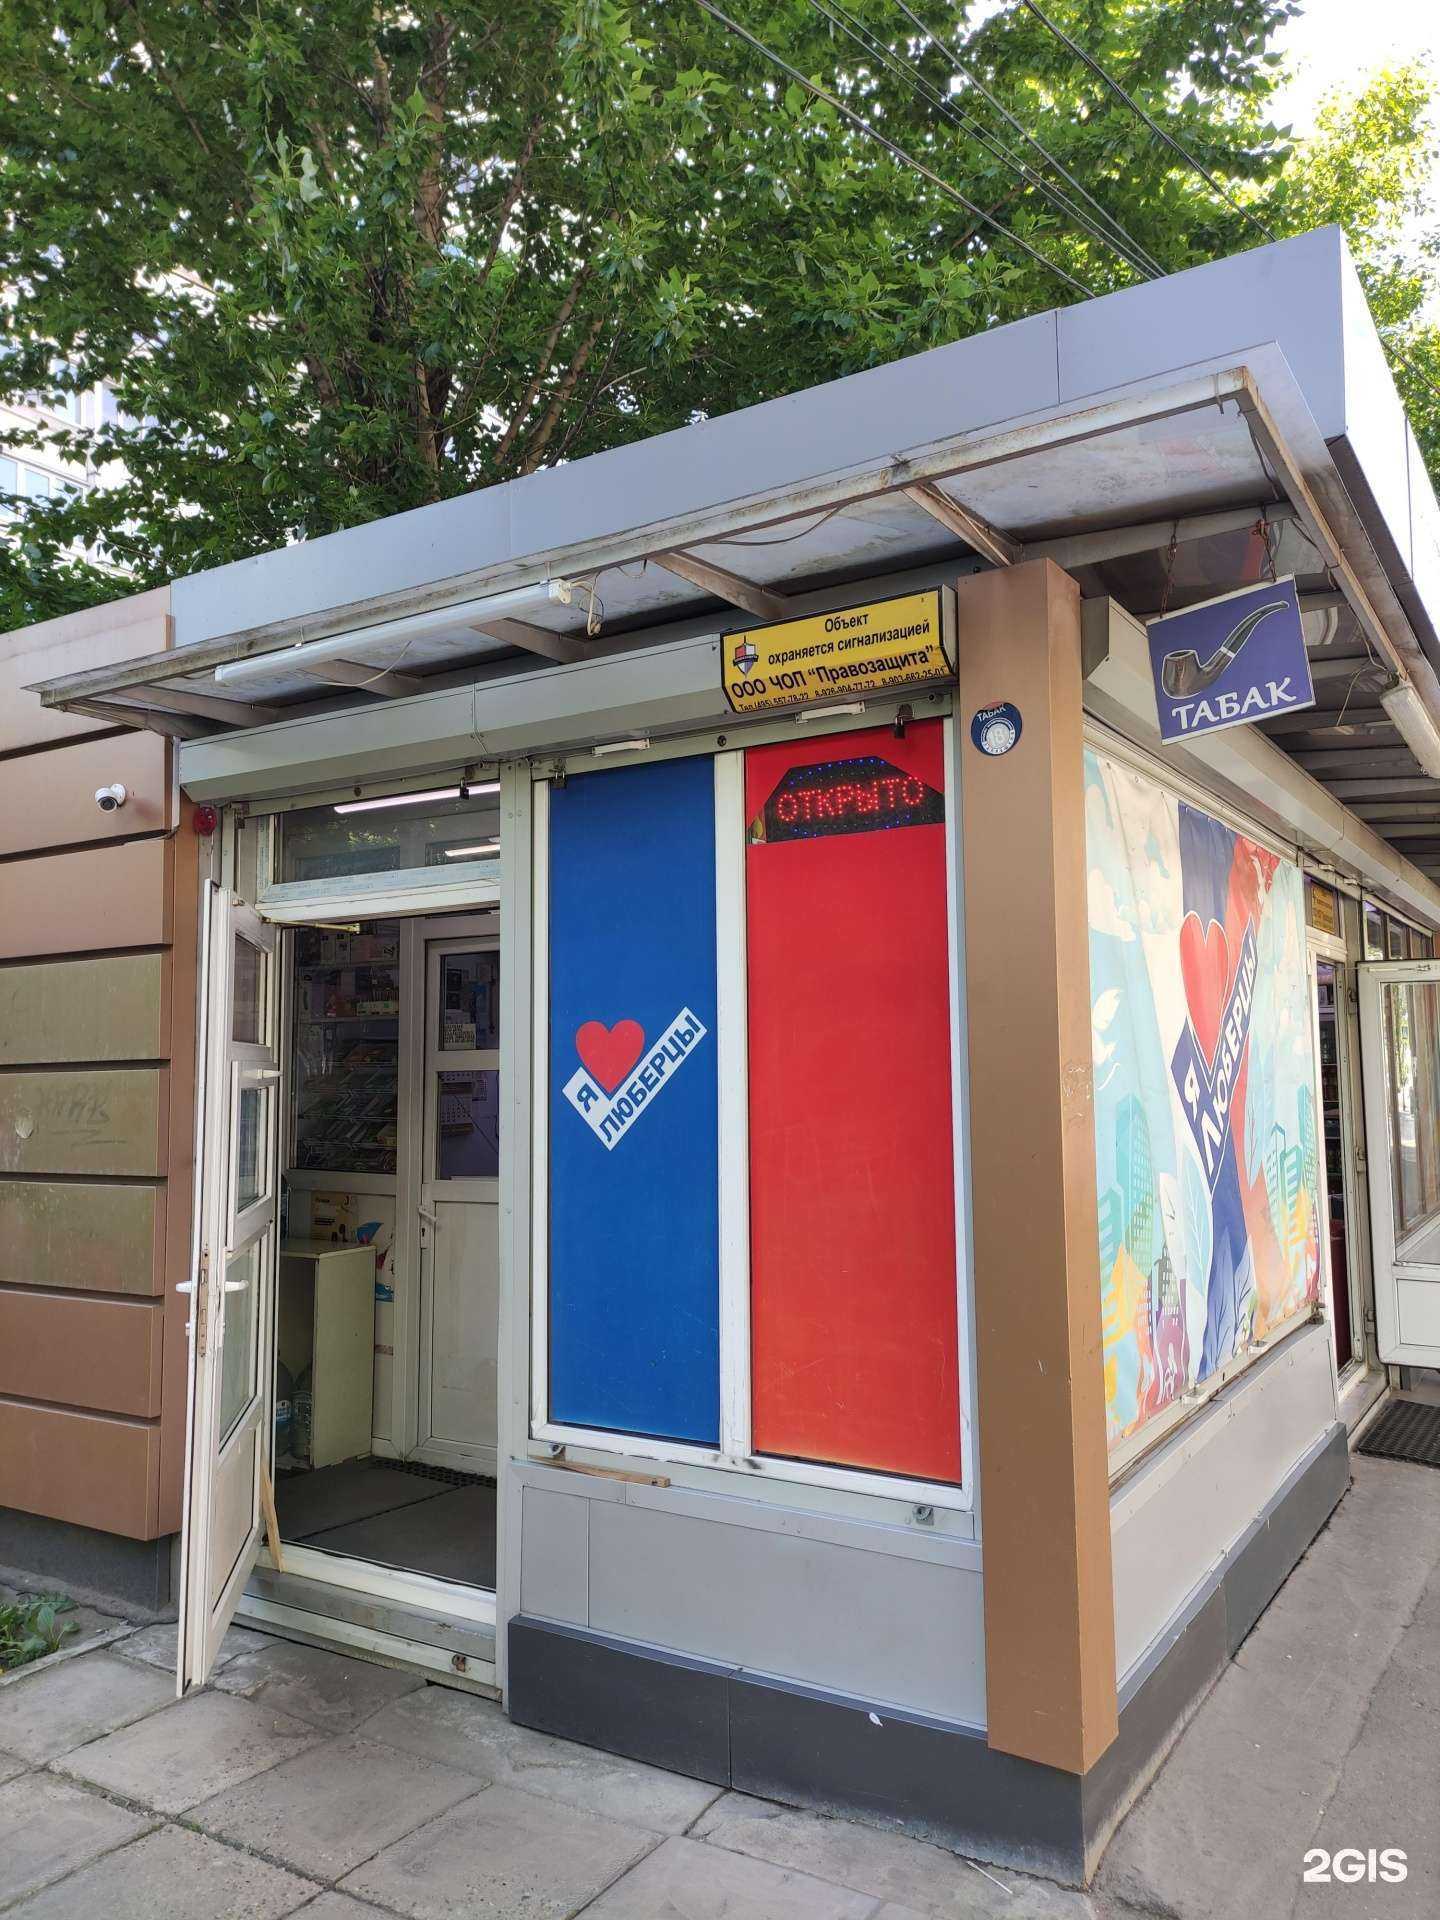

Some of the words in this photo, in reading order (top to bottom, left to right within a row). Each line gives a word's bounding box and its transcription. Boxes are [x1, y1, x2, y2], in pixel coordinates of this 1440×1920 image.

[768, 642, 834, 666] охраняется
[837, 619, 930, 651] сигнализацией
[825, 613, 869, 633] Объект
[731, 678, 767, 698] ООО
[769, 670, 807, 690] ЧОП
[1171, 676, 1297, 730] ТАБАК
[777, 776, 924, 822] ОТКРЫТО
[576, 1083, 599, 1113] Я
[598, 1014, 702, 1143] ЛЮБЕРЦЫ
